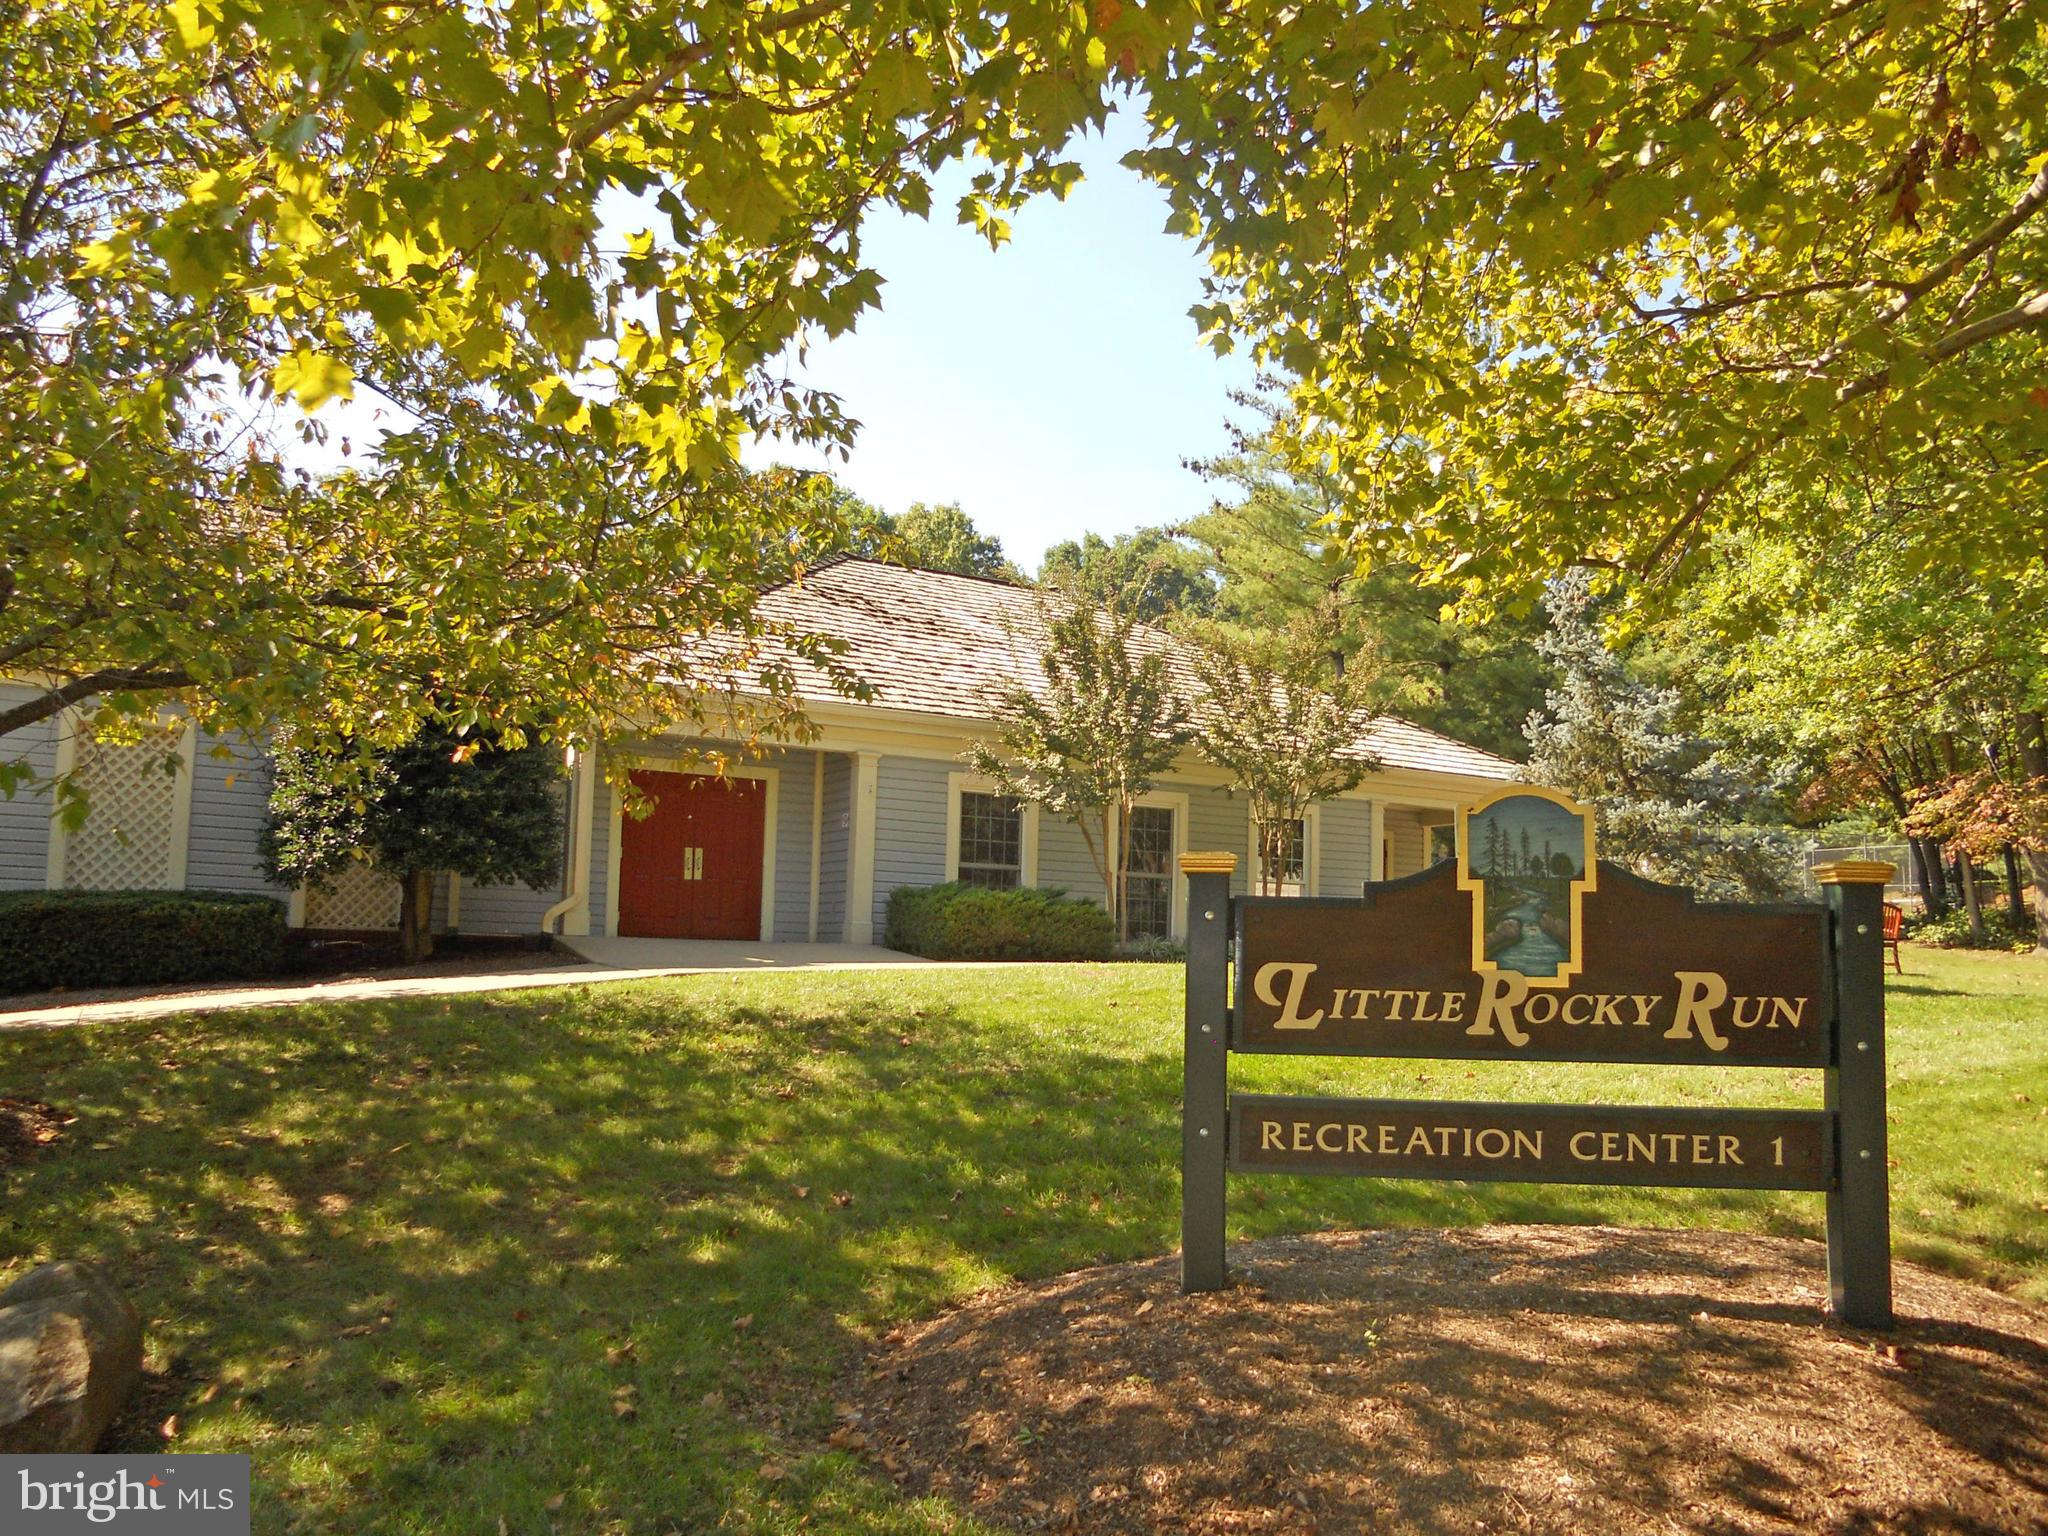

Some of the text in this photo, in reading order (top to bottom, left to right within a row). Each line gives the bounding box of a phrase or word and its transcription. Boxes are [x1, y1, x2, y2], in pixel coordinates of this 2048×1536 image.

[1261, 1121, 1784, 1166] RECREATION CENTER 1
